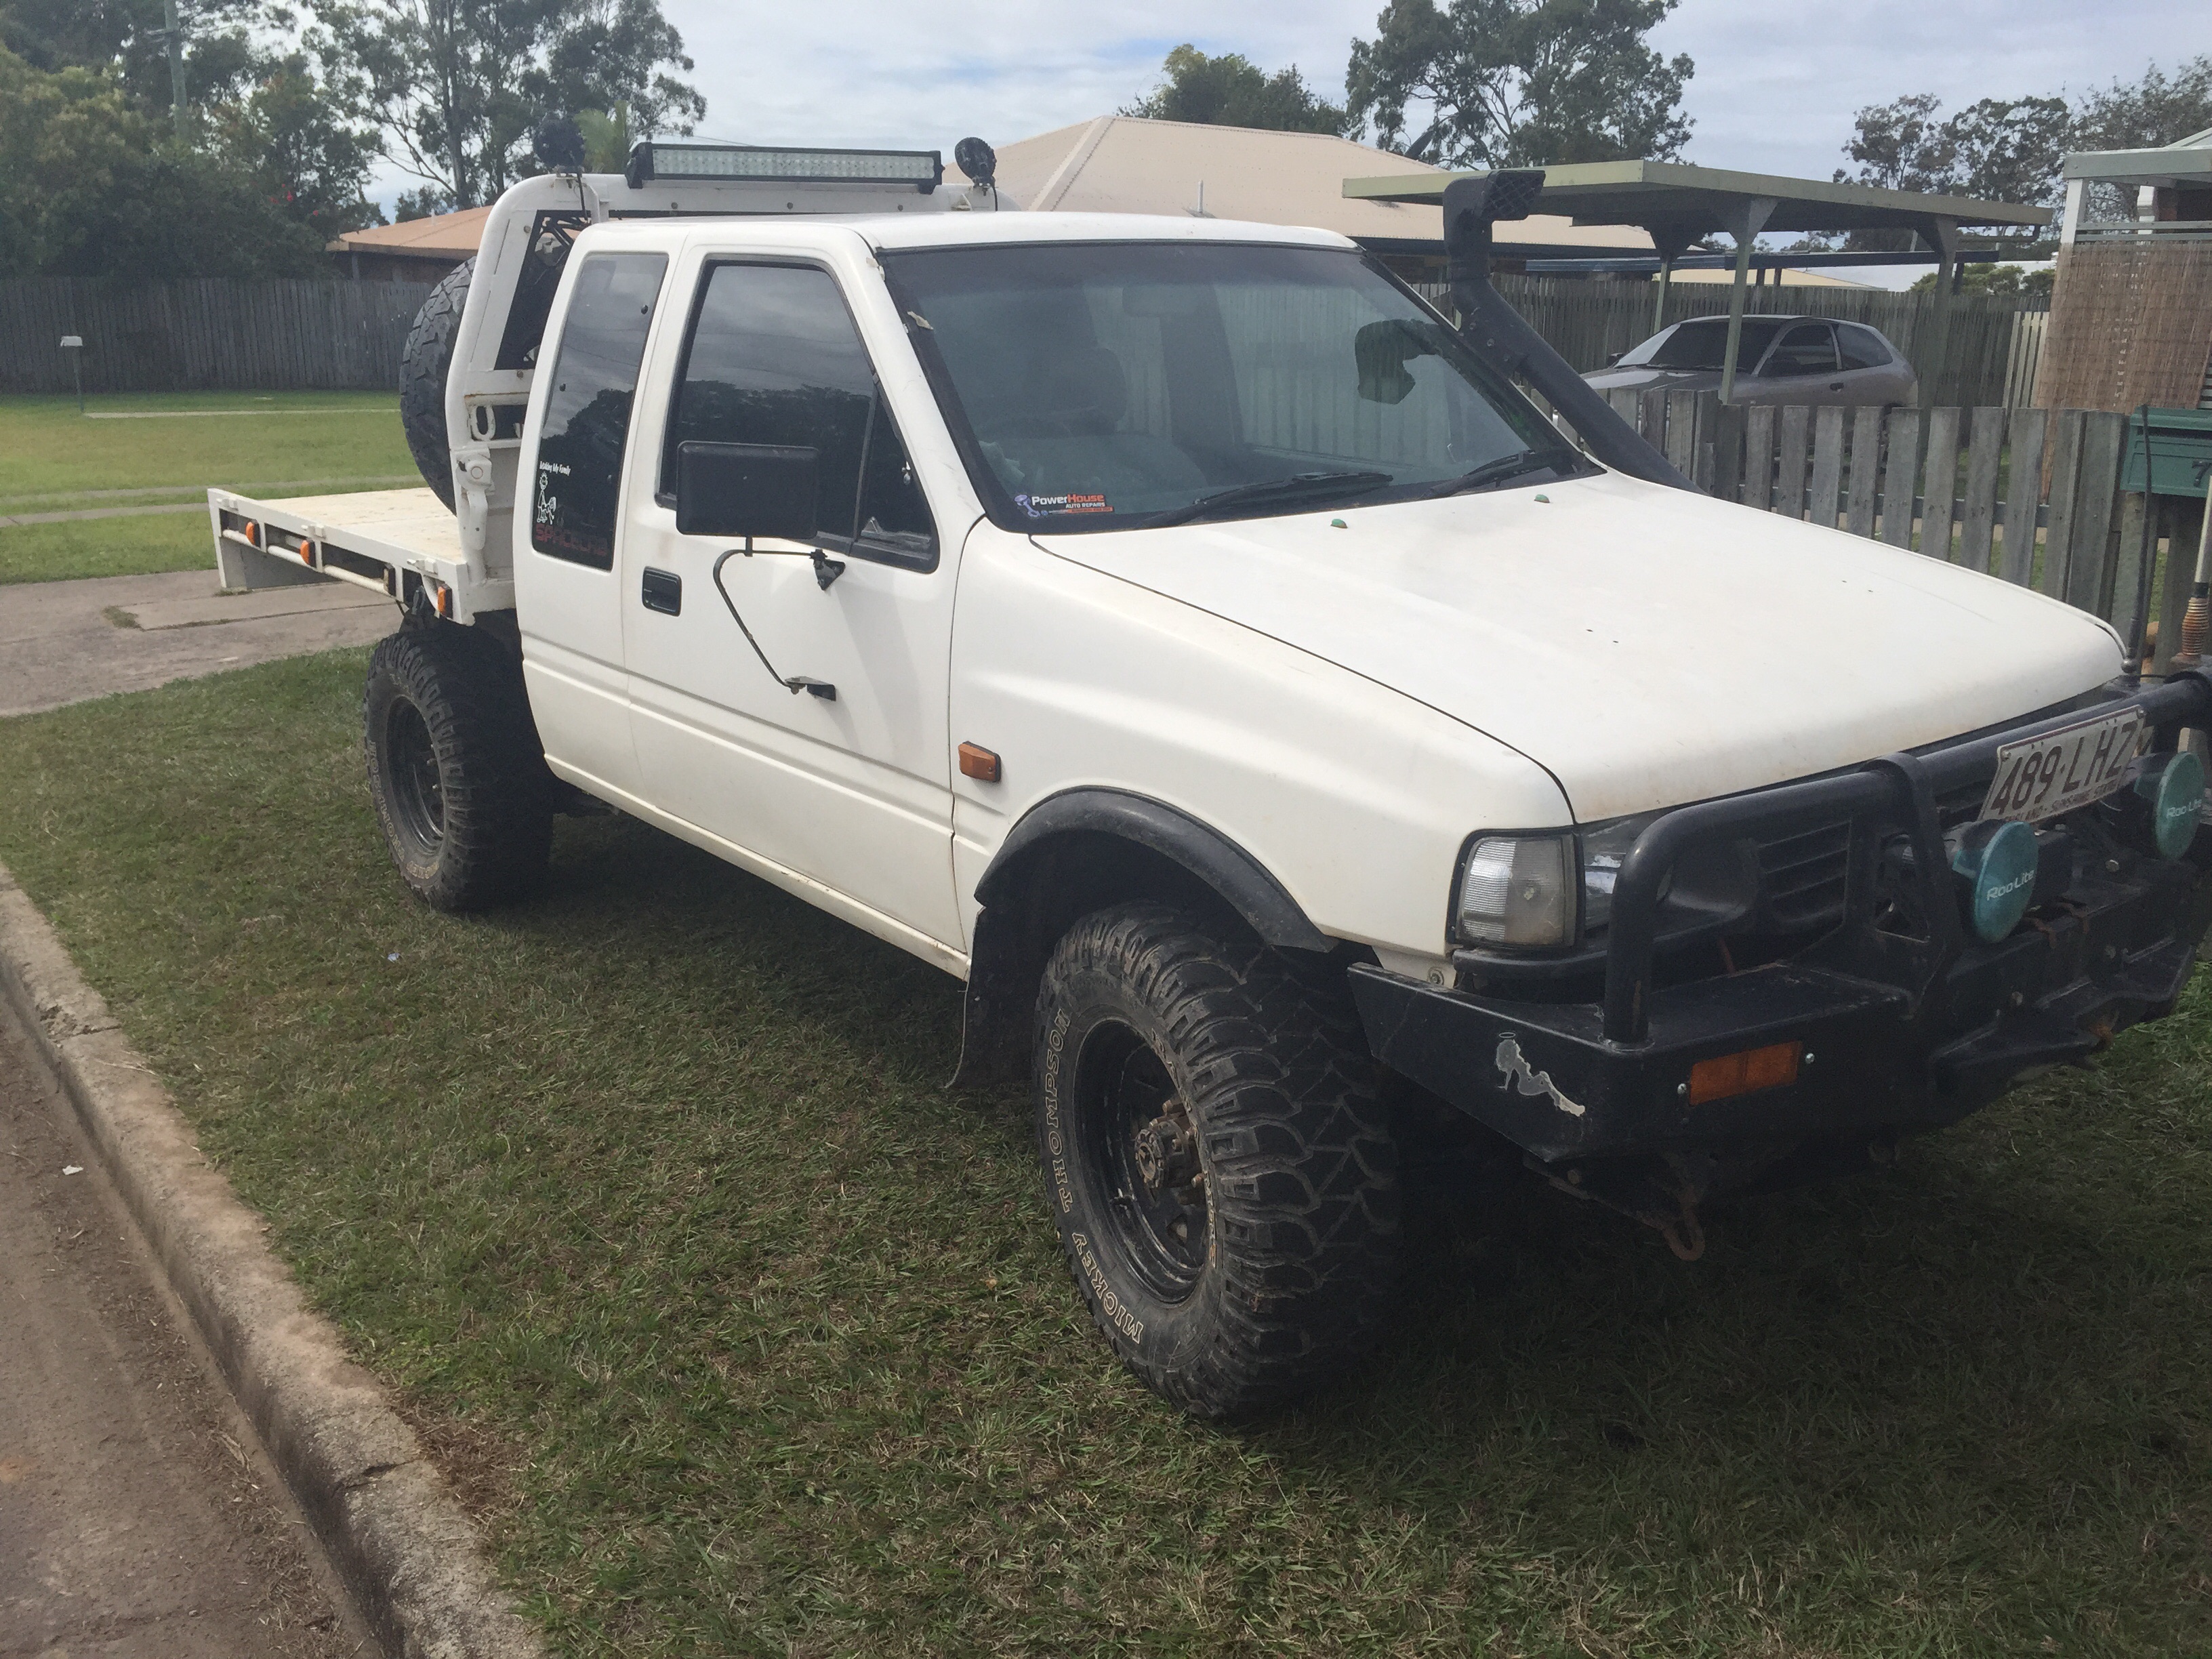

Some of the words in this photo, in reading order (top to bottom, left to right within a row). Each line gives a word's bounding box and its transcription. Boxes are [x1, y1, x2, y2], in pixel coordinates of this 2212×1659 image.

[552, 463, 560, 474] My
[1031, 493, 1104, 506] PowerHouse
[1045, 1008, 1074, 1214] THOMPSON
[1071, 1231, 1144, 1345] MICKEY
